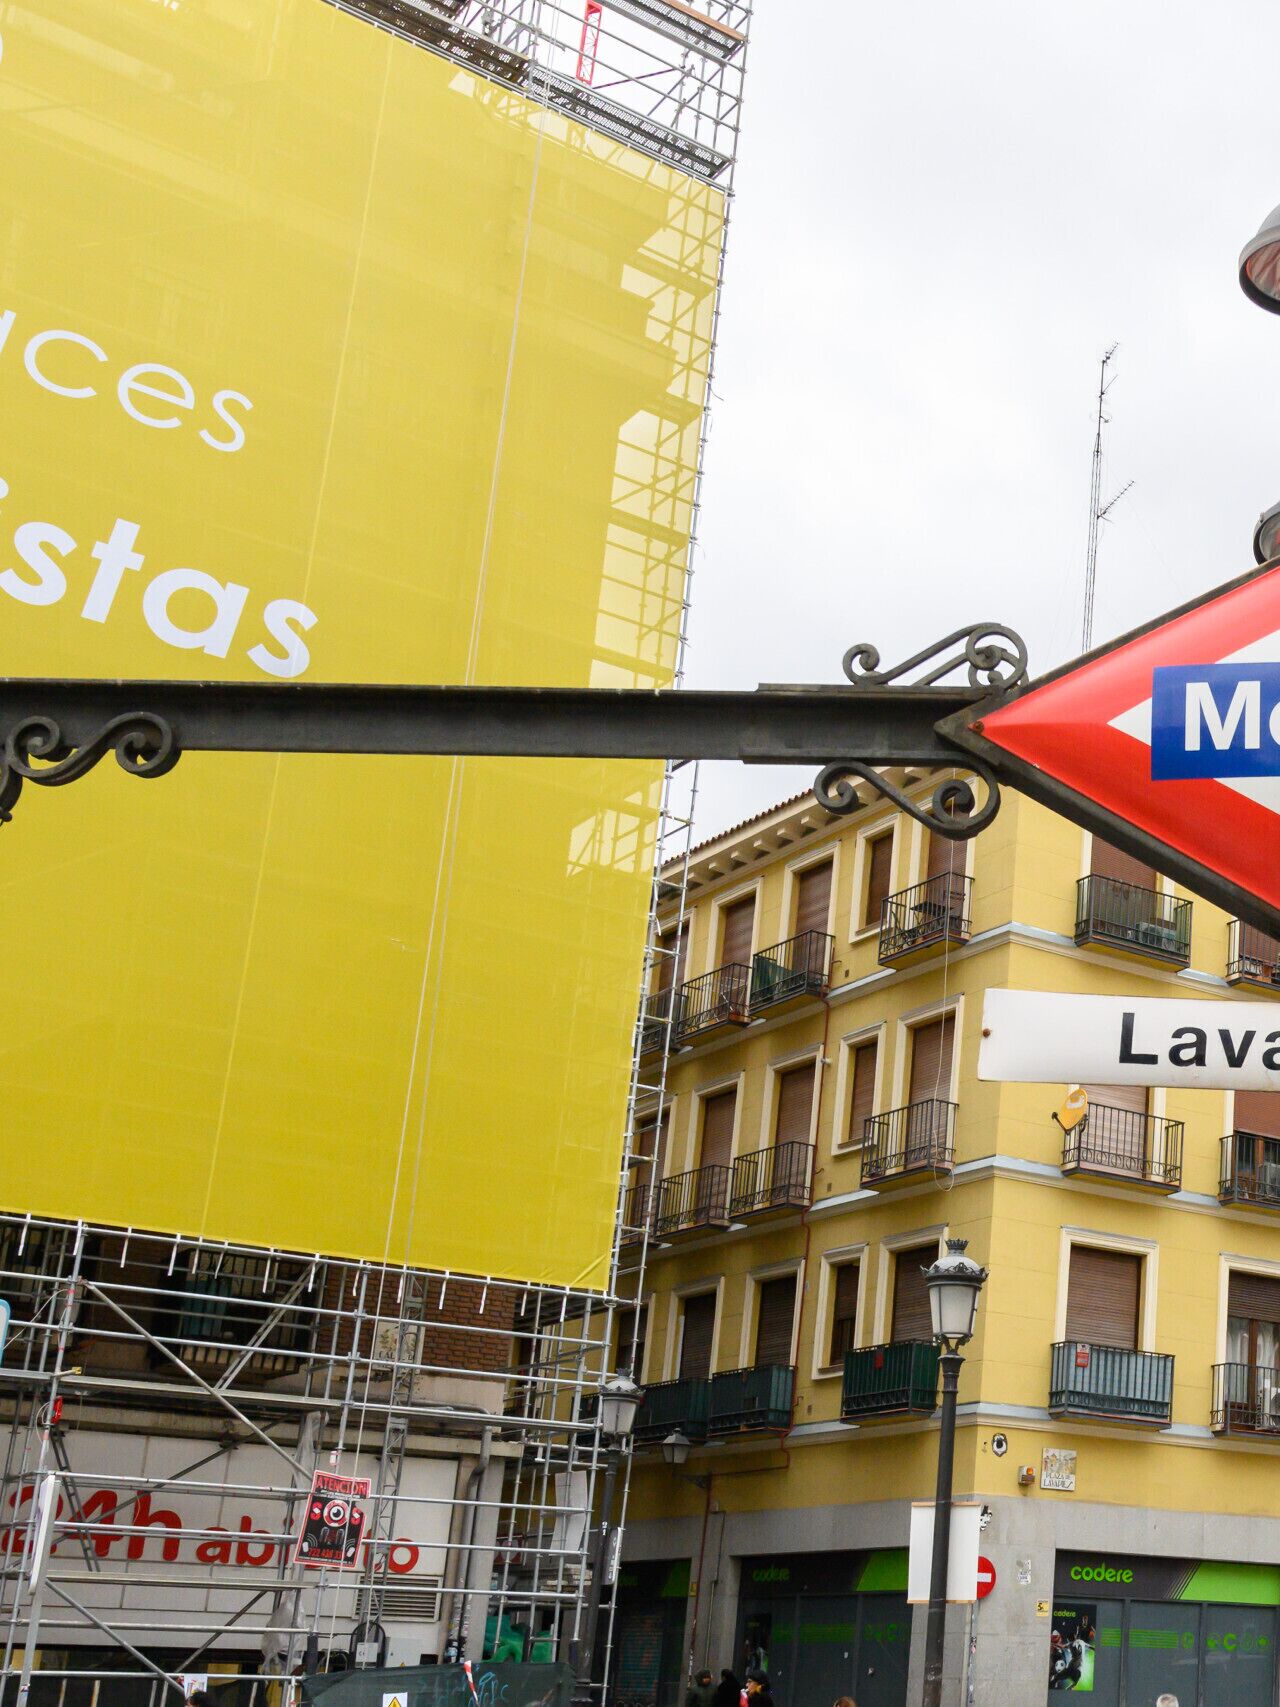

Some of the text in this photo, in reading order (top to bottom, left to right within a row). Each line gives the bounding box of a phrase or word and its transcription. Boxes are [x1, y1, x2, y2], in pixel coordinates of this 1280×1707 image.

[0, 309, 254, 453] ces
[0, 480, 318, 679] stas
[2, 1486, 420, 1574] 24h abito
[1071, 1561, 1133, 1583] codere
[1053, 1609, 1076, 1618] codere
